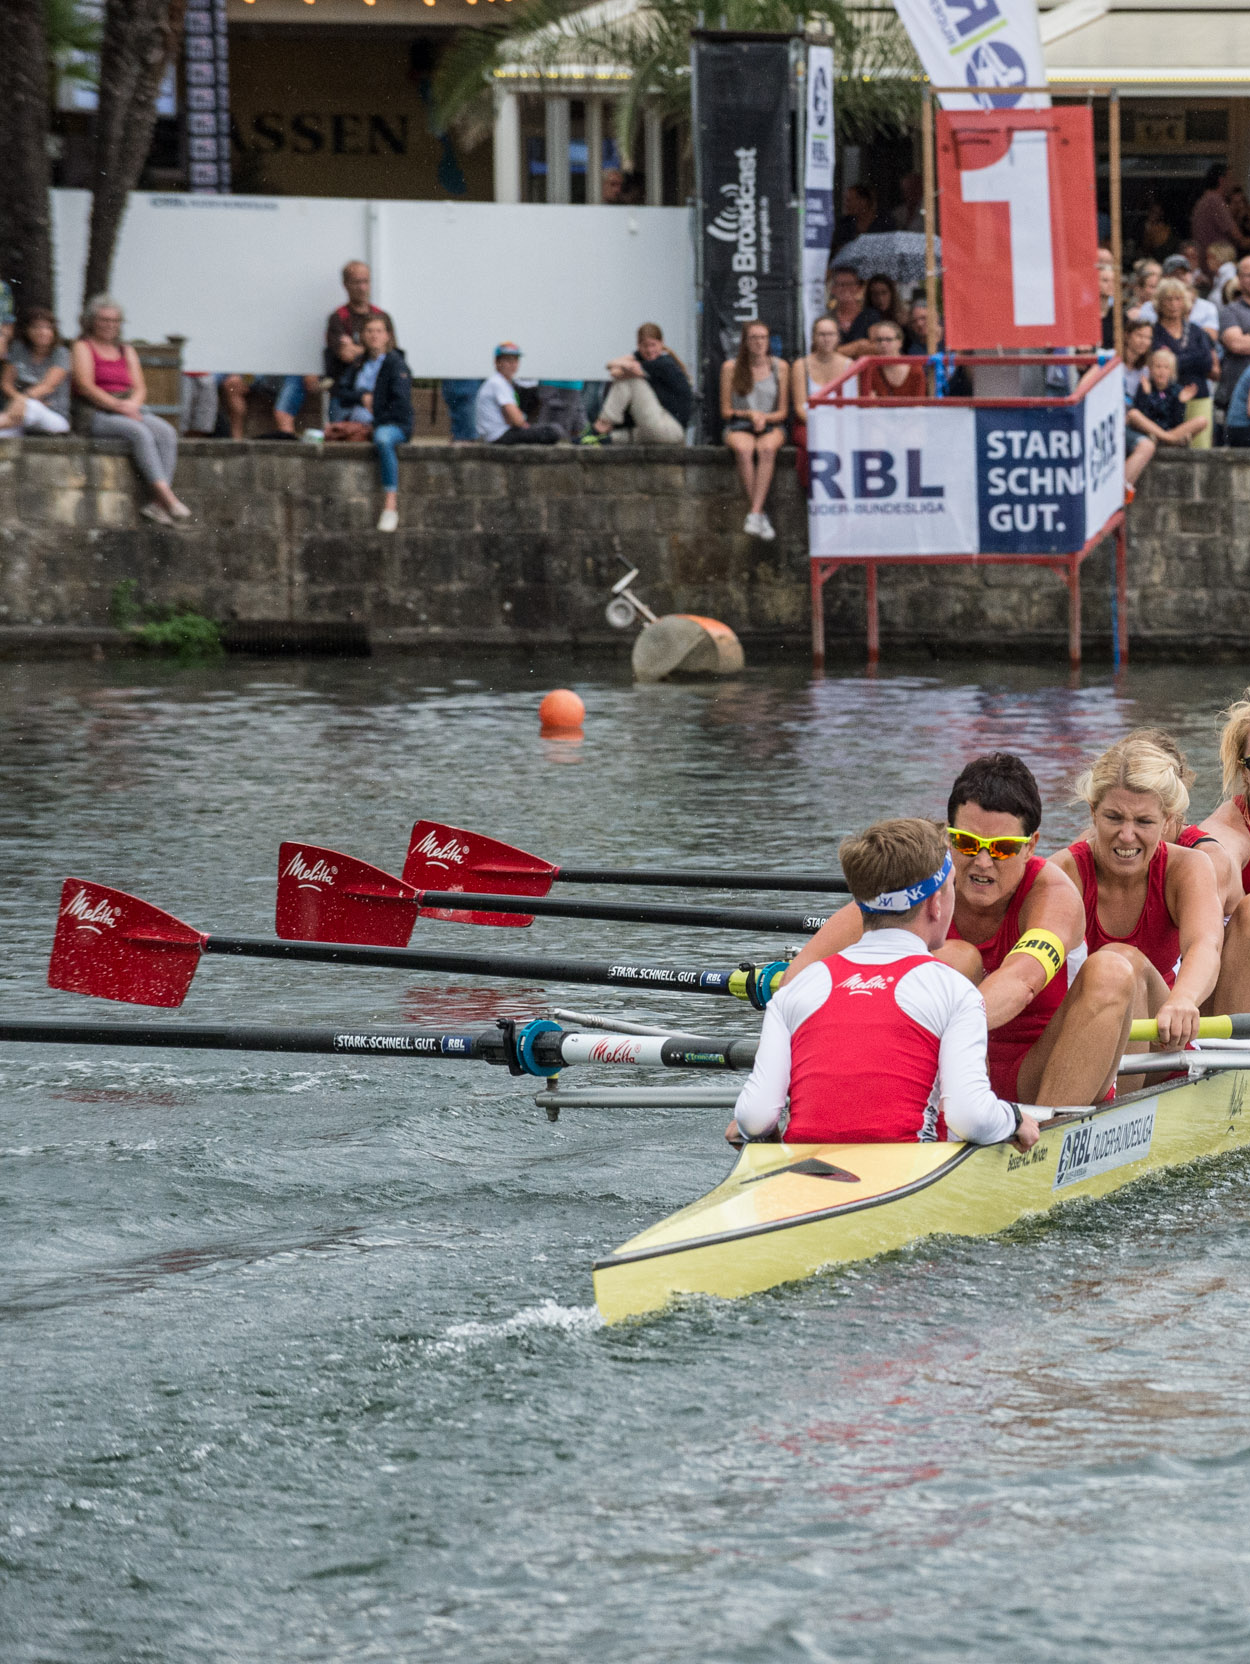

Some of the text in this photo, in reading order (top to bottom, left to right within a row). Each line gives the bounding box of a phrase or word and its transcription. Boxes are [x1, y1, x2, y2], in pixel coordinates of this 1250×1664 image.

[732, 146, 759, 322] Live Broadcast
[960, 129, 1056, 326] 1
[808, 449, 945, 499] RBL
[808, 501, 946, 516] UDER-BUNDESLIGA
[987, 503, 1066, 532] GUT.
[410, 829, 465, 864] Melitta
[281, 851, 335, 886] Melitta
[905, 885, 926, 901] NK
[61, 888, 117, 929] Melitta
[806, 917, 829, 929] STAR
[610, 966, 696, 983] STARK. SCHNELL. GUT.
[706, 972, 722, 982] RBL
[835, 972, 888, 990] Melitta
[336, 1034, 437, 1050] STARK. SCHNELL. GUT.
[448, 1037, 465, 1049] RBL
[588, 1036, 640, 1065] Melitta
[1069, 1113, 1154, 1169] RBL RUDER-BUNDESLIGA
